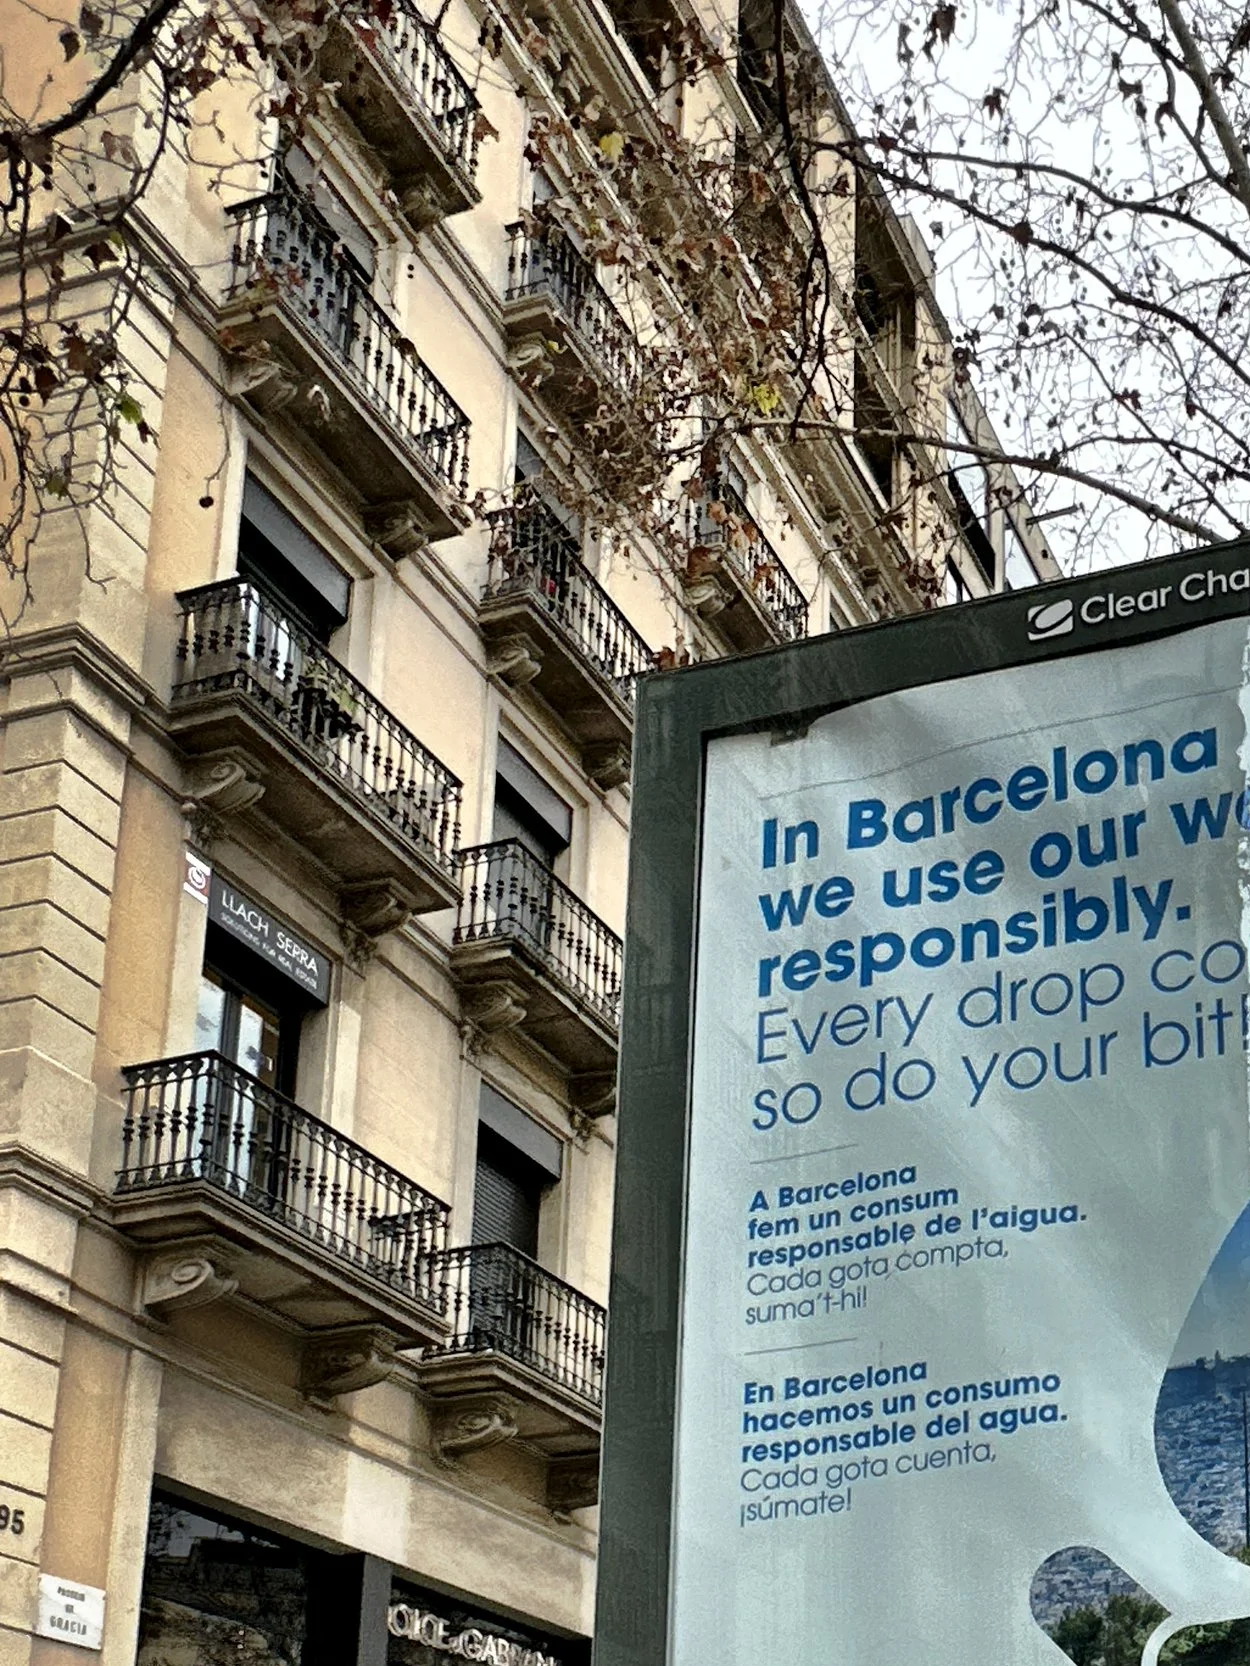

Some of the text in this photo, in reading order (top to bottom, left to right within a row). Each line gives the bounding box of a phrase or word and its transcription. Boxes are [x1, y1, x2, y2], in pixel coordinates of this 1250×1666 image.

[1080, 583, 1173, 626] Clear
[762, 727, 1219, 869] In Barcelona
[758, 873, 855, 931] we
[881, 847, 1005, 906] use
[1029, 809, 1146, 879] our
[222, 889, 318, 977] LLACH SERRA
[757, 875, 1191, 998] responsibly.
[757, 989, 933, 1064] Every
[957, 961, 1125, 1024] drop
[752, 994, 1250, 1131] so do your bit!
[748, 1187, 959, 1240] fem un consum
[749, 1165, 917, 1212] A Barcelona
[747, 1236, 1009, 1296] Cada gota compta,
[748, 1222, 916, 1268] responsable
[925, 1213, 962, 1237] de
[743, 1372, 1061, 1434] hacemos un consumo
[744, 1360, 927, 1405] En Barcelona
[741, 1402, 1068, 1464] responsable del agua.
[740, 1440, 997, 1493] Cada gota cuenta,
[740, 1488, 852, 1527] ¡súmate!
